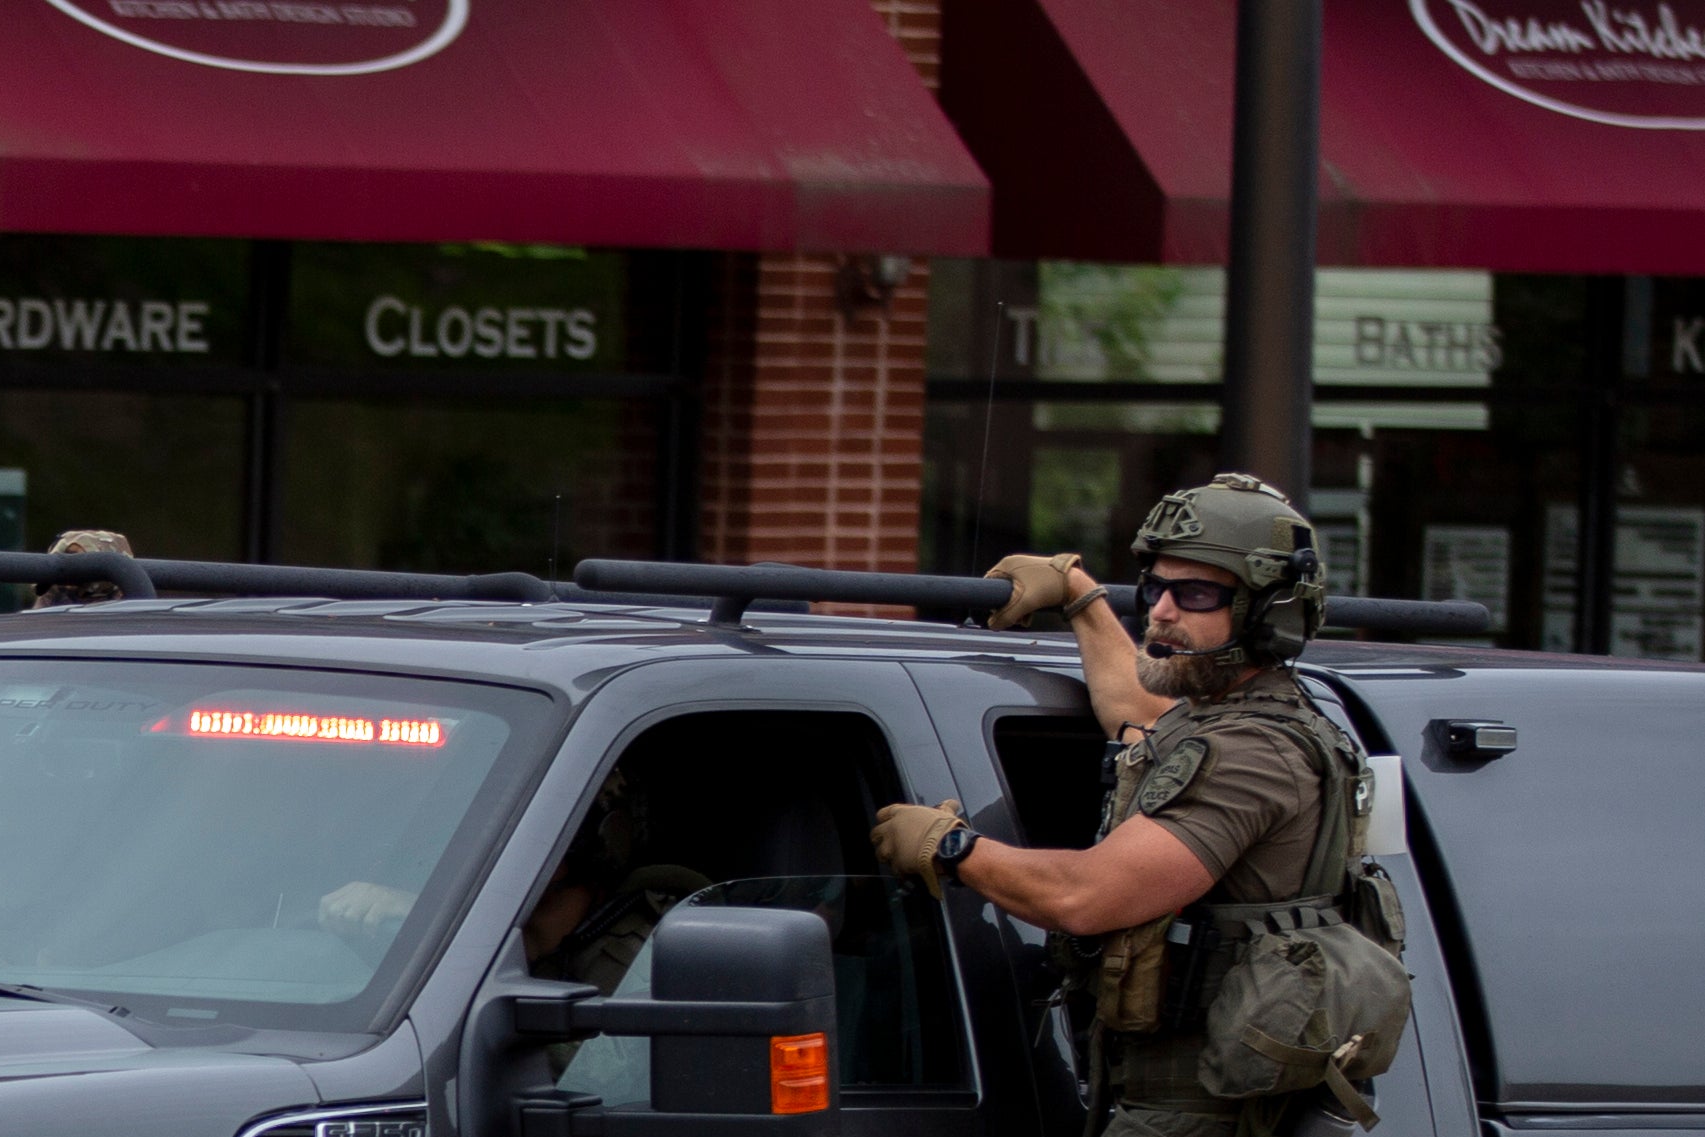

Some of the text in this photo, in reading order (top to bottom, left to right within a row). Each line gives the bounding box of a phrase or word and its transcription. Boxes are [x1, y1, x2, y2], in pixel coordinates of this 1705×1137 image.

[1453, 0, 1596, 54] Dream
[363, 296, 597, 358] CLOSETS
[1354, 315, 1505, 373] BATHS
[64, 699, 157, 712] DUTY
